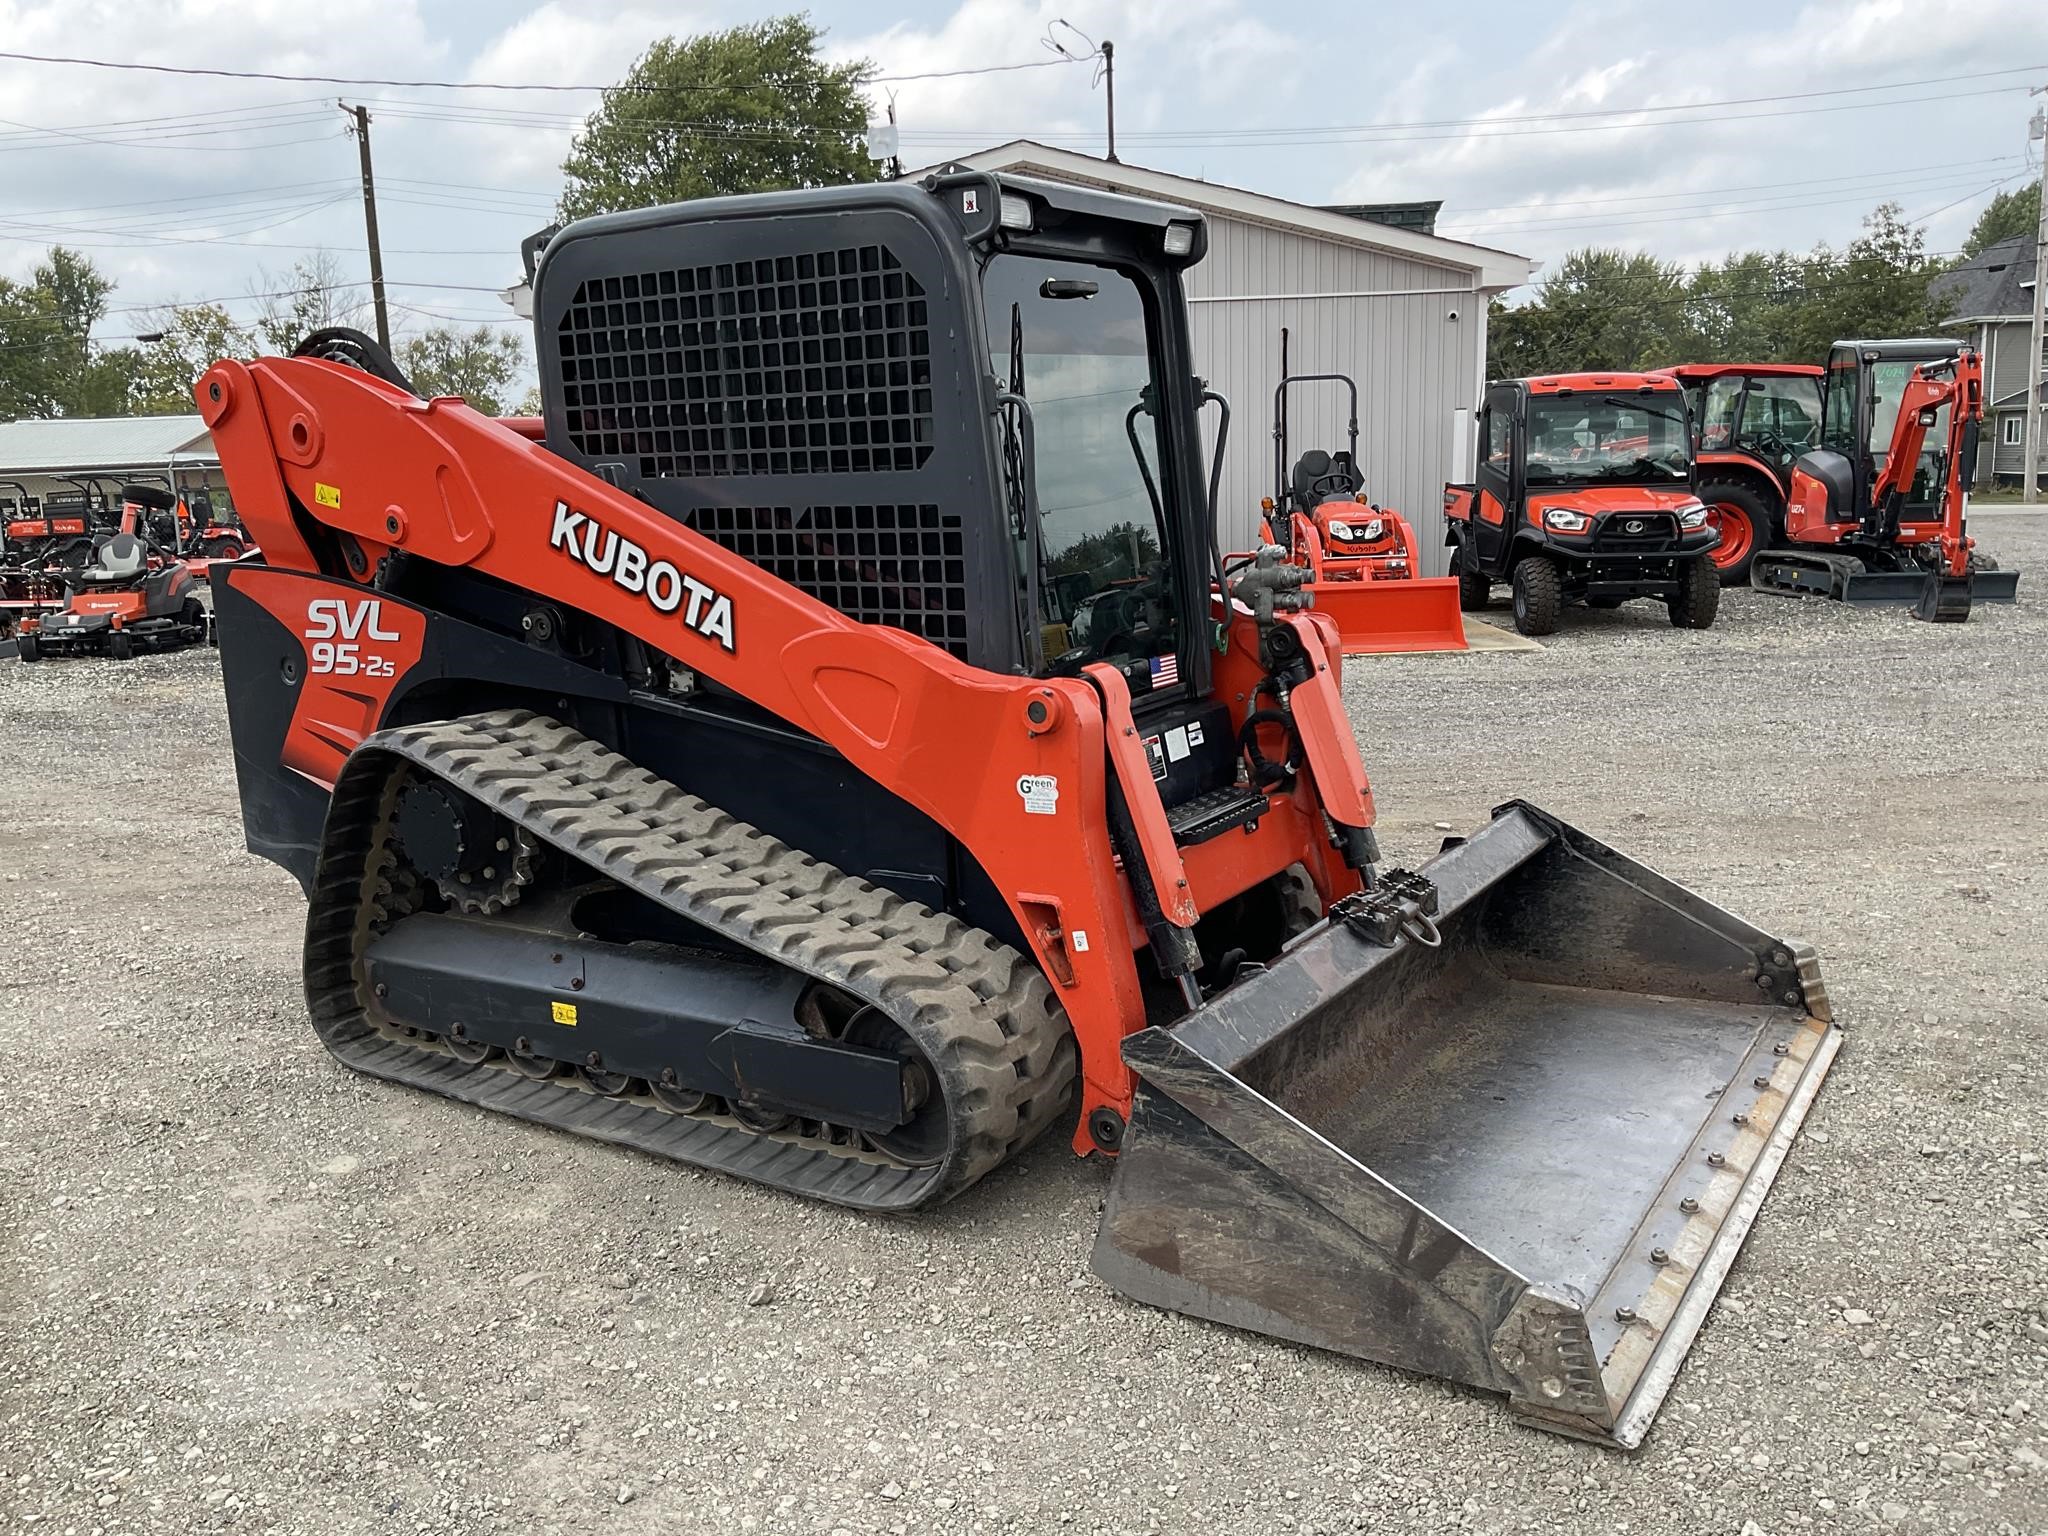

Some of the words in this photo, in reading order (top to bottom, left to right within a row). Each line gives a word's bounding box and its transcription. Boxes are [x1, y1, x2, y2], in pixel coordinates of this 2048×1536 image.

[550, 499, 735, 652] KUBOTA
[305, 599, 400, 641] SVL
[1019, 779, 1053, 794] Green
